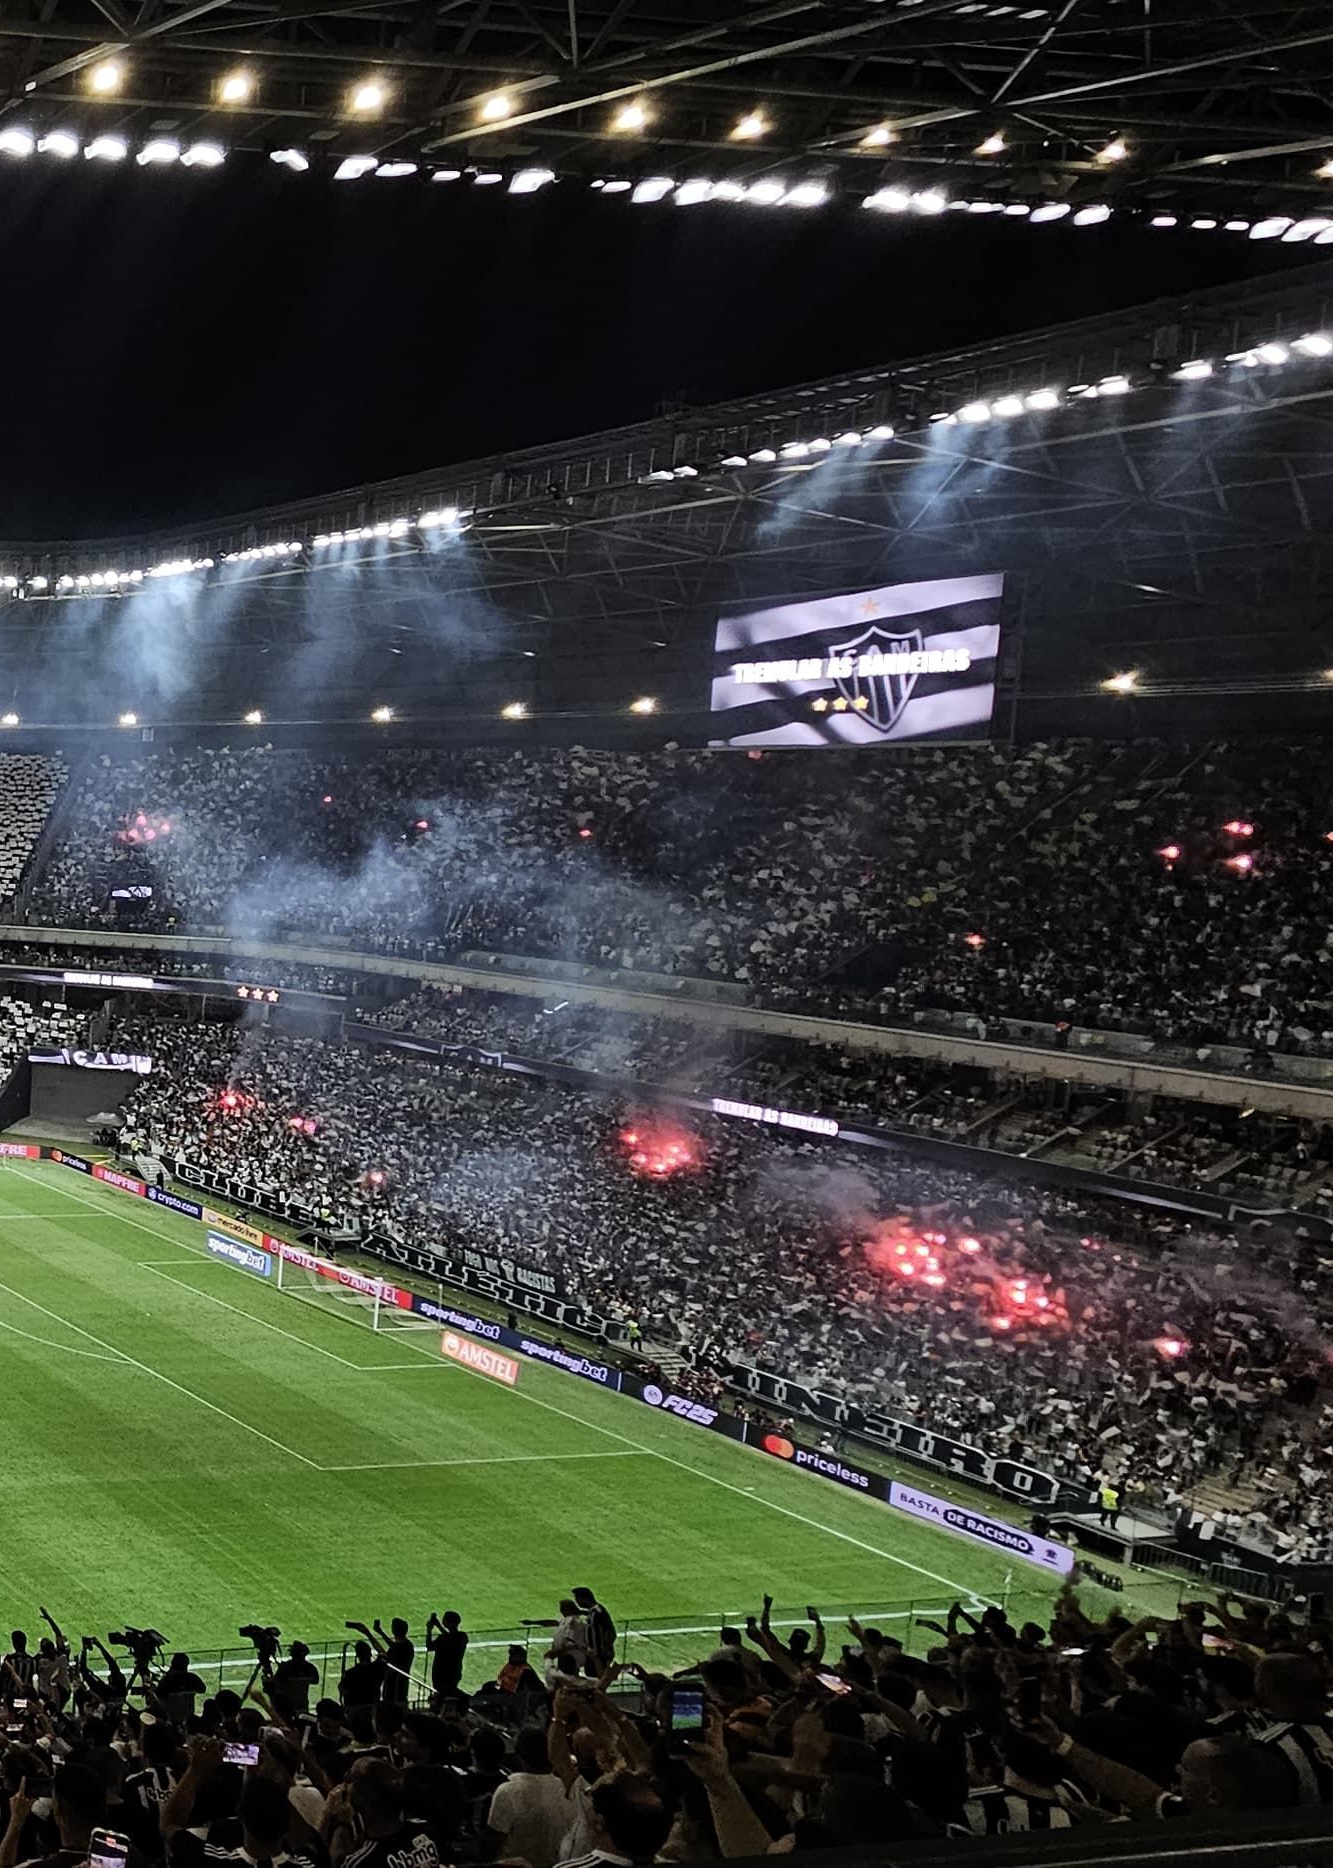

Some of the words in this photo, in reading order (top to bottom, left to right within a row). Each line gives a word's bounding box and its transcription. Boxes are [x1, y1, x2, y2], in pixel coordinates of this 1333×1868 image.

[734, 659, 822, 684] TREMULAR
[827, 656, 853, 679] AS
[859, 648, 970, 677] BANDEIRAS
[104, 1170, 141, 1193] MAPFRE
[176, 1162, 316, 1228] CLUBE
[158, 1193, 199, 1215] crypto.com
[217, 1213, 245, 1236] mercado
[208, 1237, 265, 1273] sportingbet
[420, 1301, 501, 1340] sportingbet
[459, 1343, 515, 1383] AMSTEL
[521, 1340, 608, 1383] sportingbet
[662, 1394, 719, 1425] FC25
[796, 1450, 869, 1487] priceless
[900, 1492, 939, 1516] BASTA
[947, 1511, 966, 1528] DE
[966, 1519, 1029, 1552] RACISMO
[405, 1840, 438, 1867] bmg
